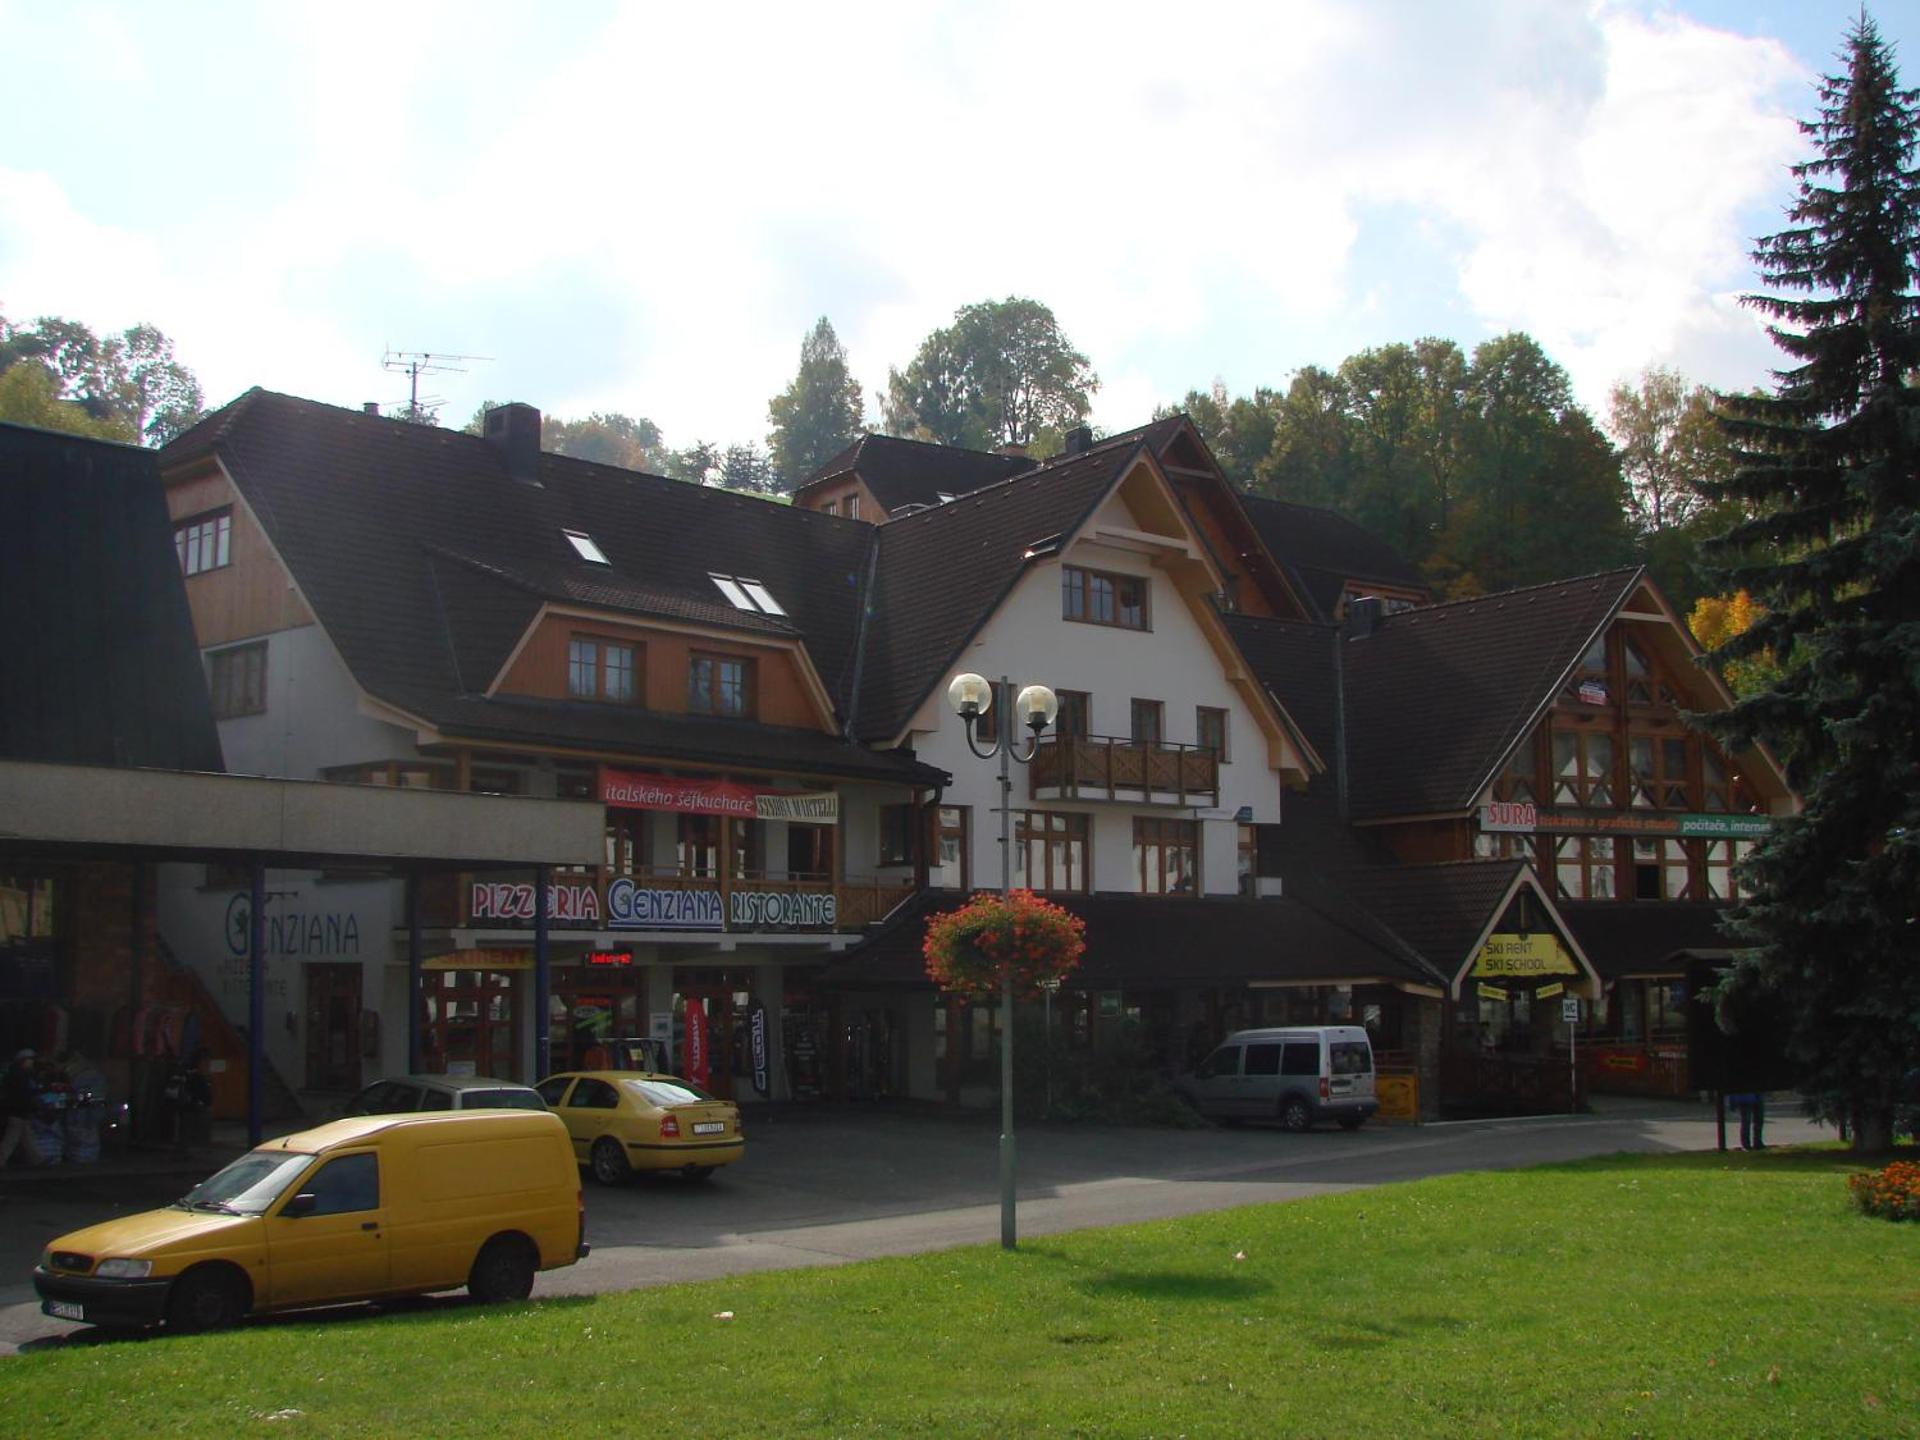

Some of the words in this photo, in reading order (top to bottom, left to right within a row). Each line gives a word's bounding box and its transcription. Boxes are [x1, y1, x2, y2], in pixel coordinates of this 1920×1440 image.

[605, 783, 674, 806] italského
[1488, 801, 1537, 826] SURA
[731, 892, 837, 925] RISTORANTE
[225, 891, 360, 956] GNZIANA
[1486, 943, 1504, 954] SKI
[1506, 943, 1533, 954] RENT
[1486, 959, 1504, 971] SKI
[1506, 959, 1547, 970] SCHOOL
[1564, 1003, 1576, 1013] WC
